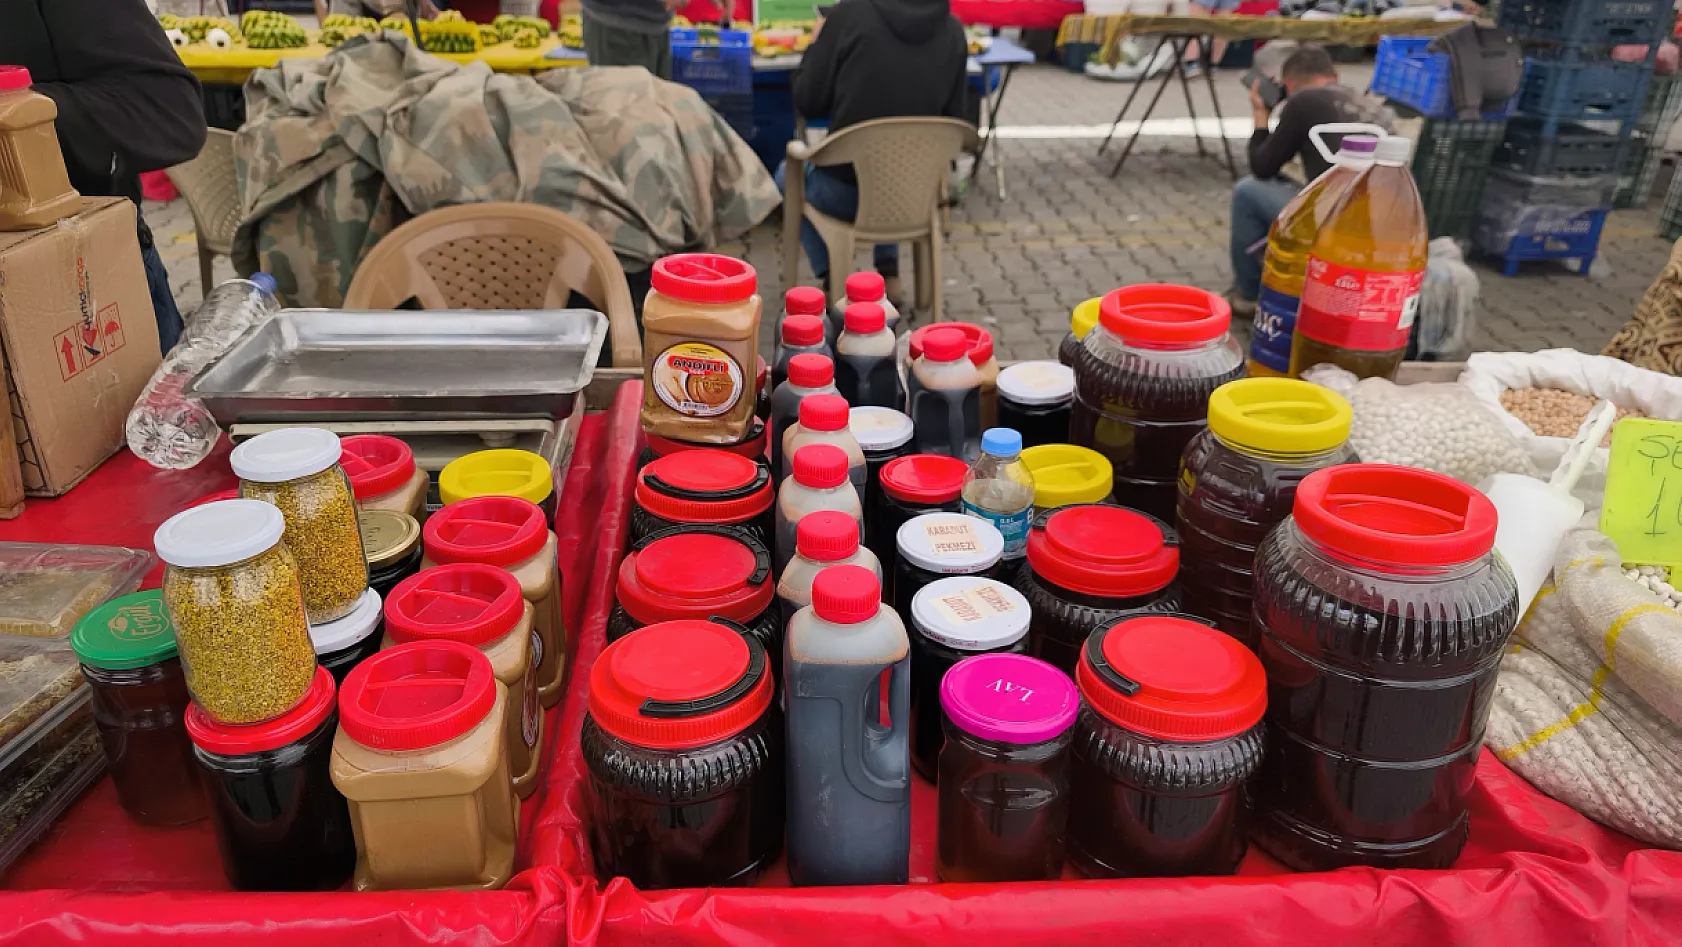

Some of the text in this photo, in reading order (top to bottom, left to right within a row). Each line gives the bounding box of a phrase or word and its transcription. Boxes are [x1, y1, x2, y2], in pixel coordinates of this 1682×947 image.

[1645, 477, 1682, 537] 1
[926, 524, 969, 536] KARADUT
[985, 678, 1035, 705] LAV
